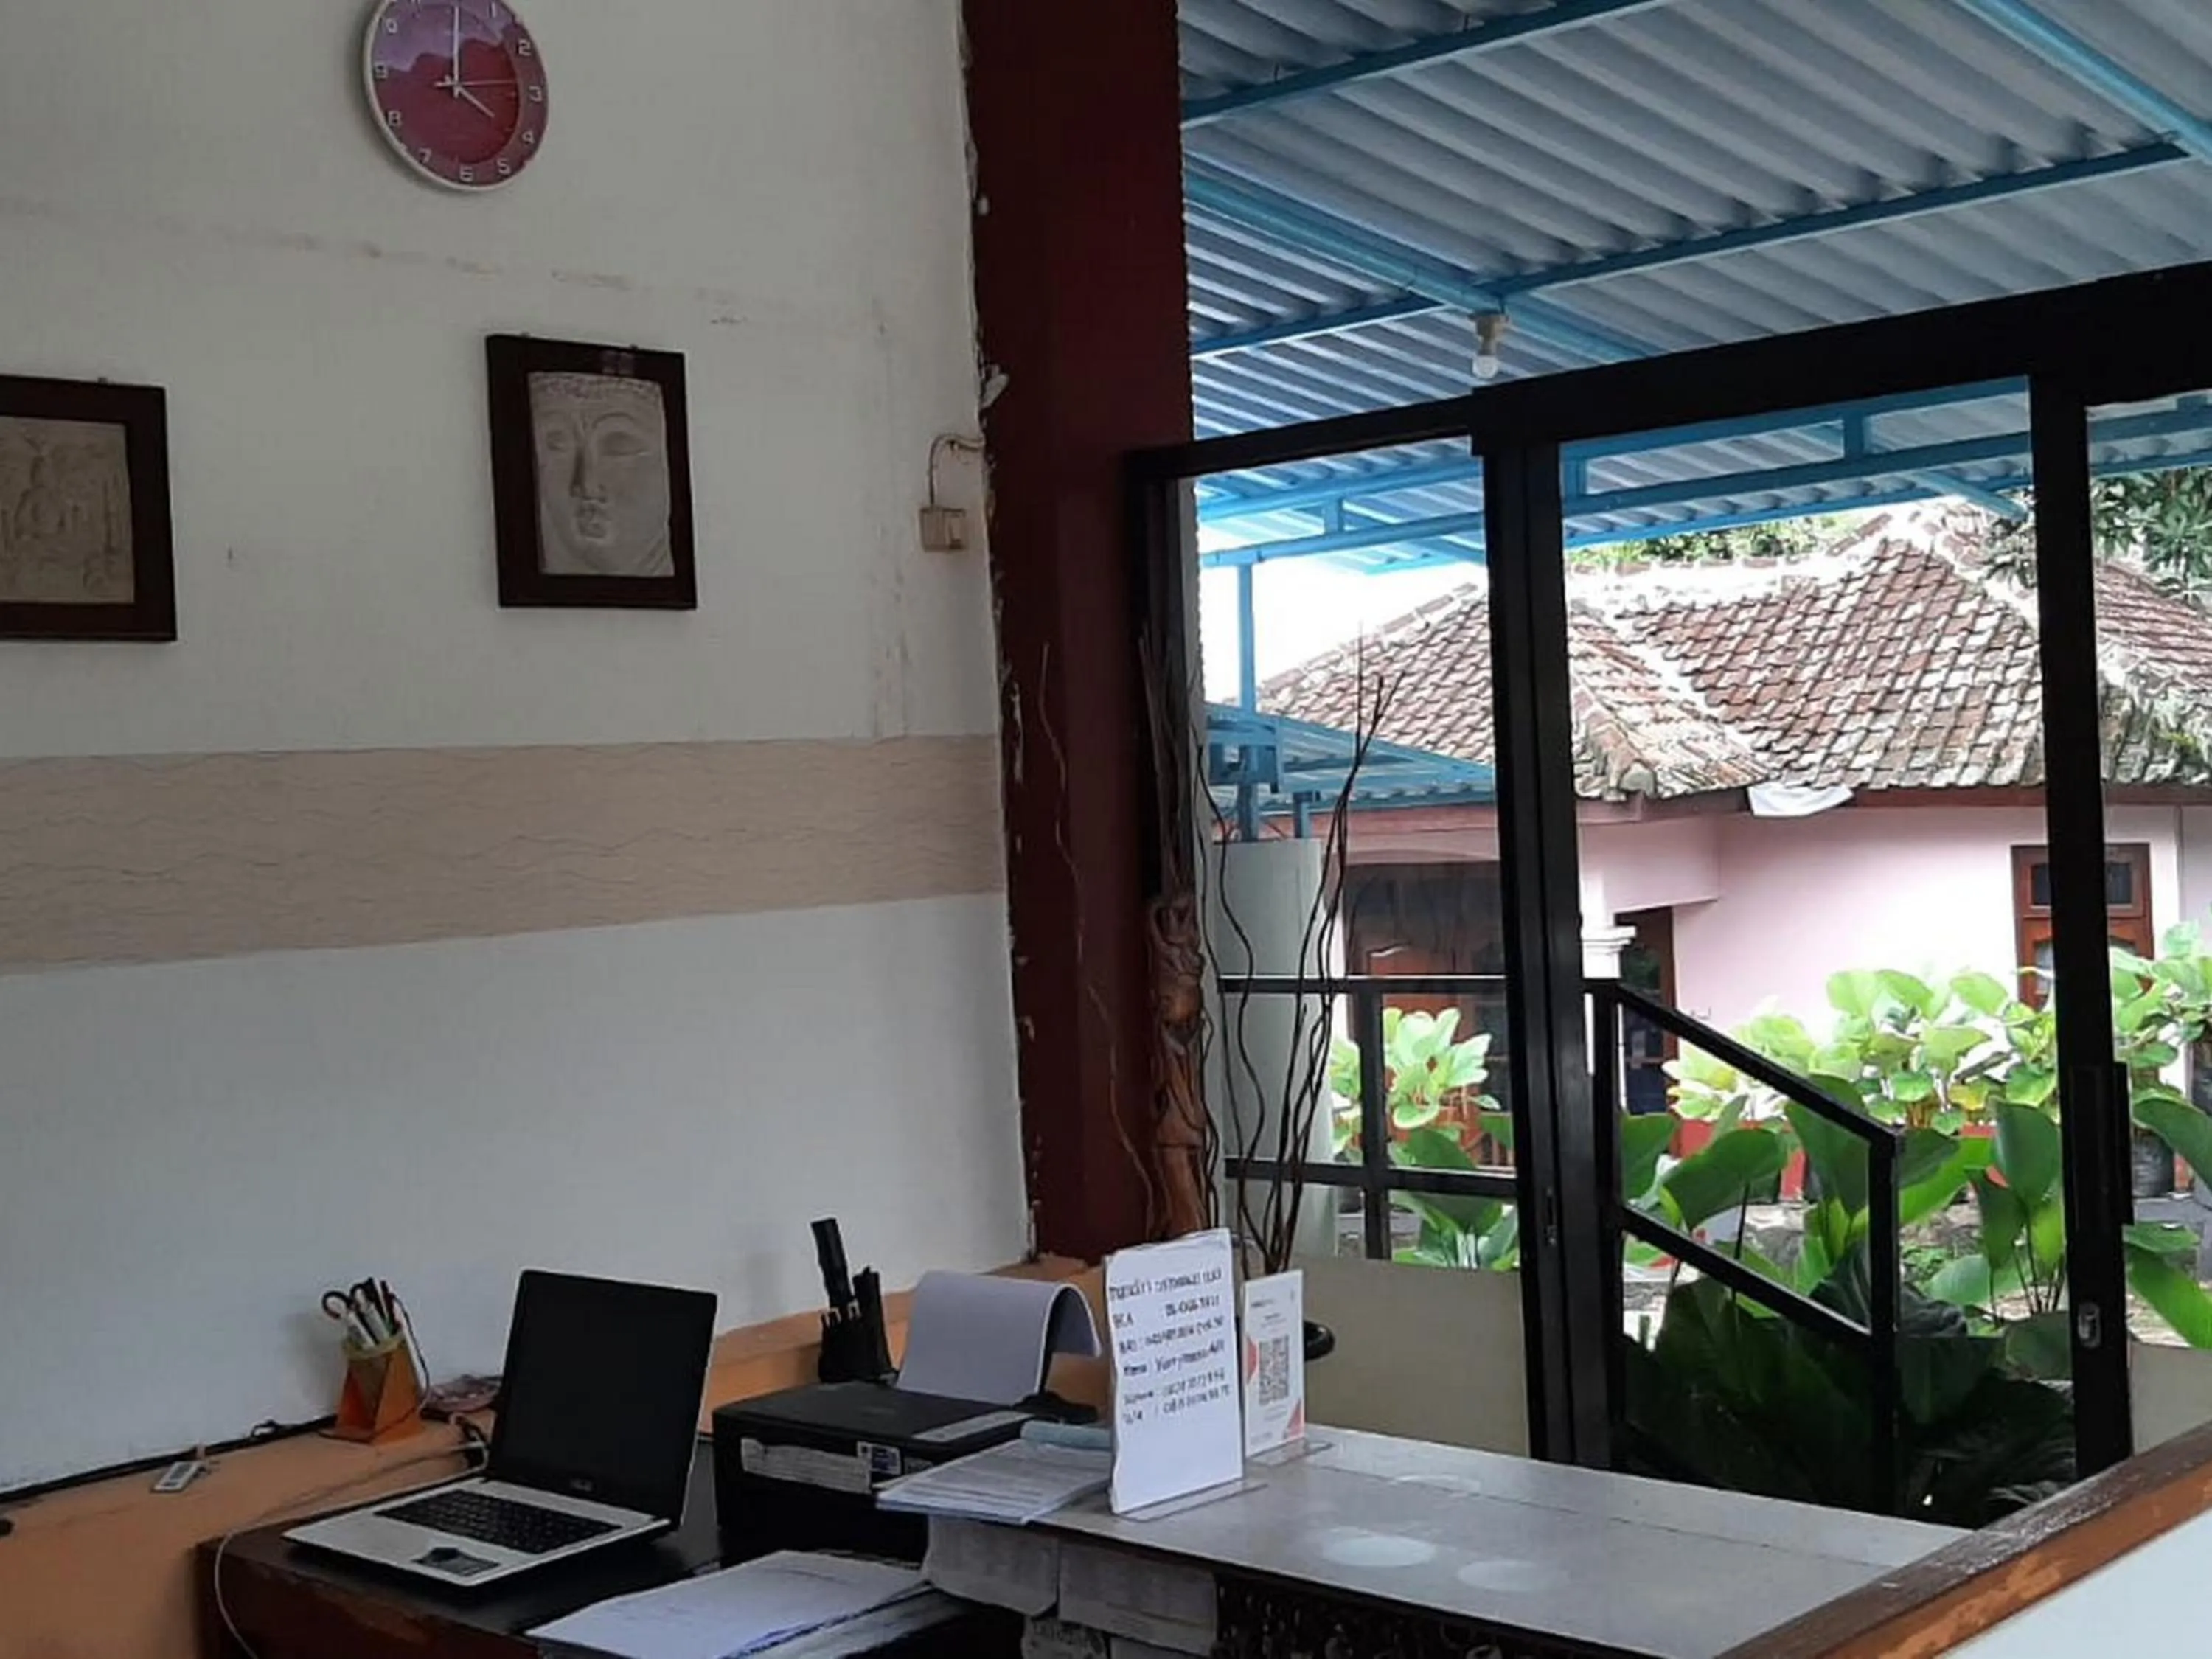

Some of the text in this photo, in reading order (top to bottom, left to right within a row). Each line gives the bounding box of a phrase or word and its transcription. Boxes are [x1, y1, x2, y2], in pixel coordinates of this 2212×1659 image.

[518, 39, 531, 56] 2
[375, 61, 388, 79] 9
[529, 86, 542, 102] 3
[389, 111, 402, 126] 8
[522, 131, 534, 144] 4
[419, 148, 431, 164] 7
[459, 165, 473, 181] 6
[496, 157, 511, 174] 5
